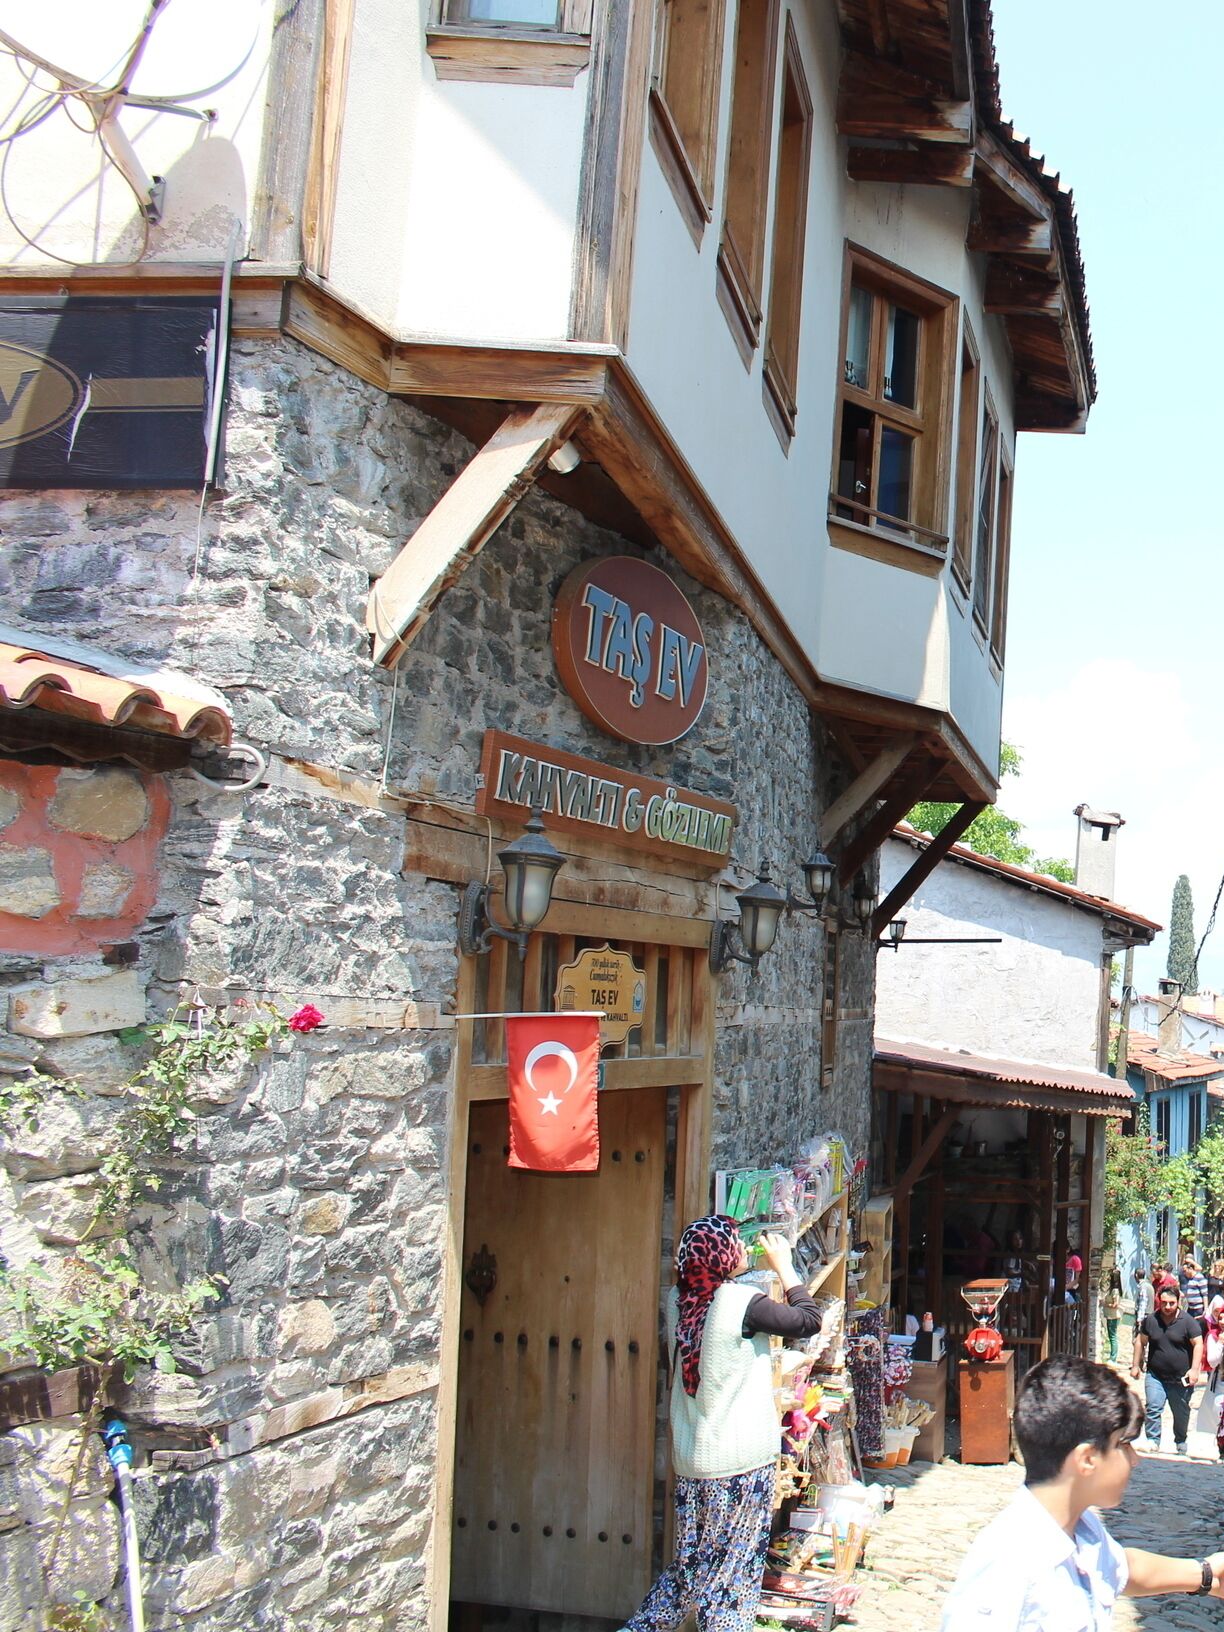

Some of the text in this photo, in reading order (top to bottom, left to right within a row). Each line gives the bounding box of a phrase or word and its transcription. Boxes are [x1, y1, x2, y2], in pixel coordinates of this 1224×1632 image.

[581, 583, 704, 708] TAŞ EV
[494, 749, 732, 855] KAHVALTI & GÖZLEME
[608, 989, 619, 1005] EV
